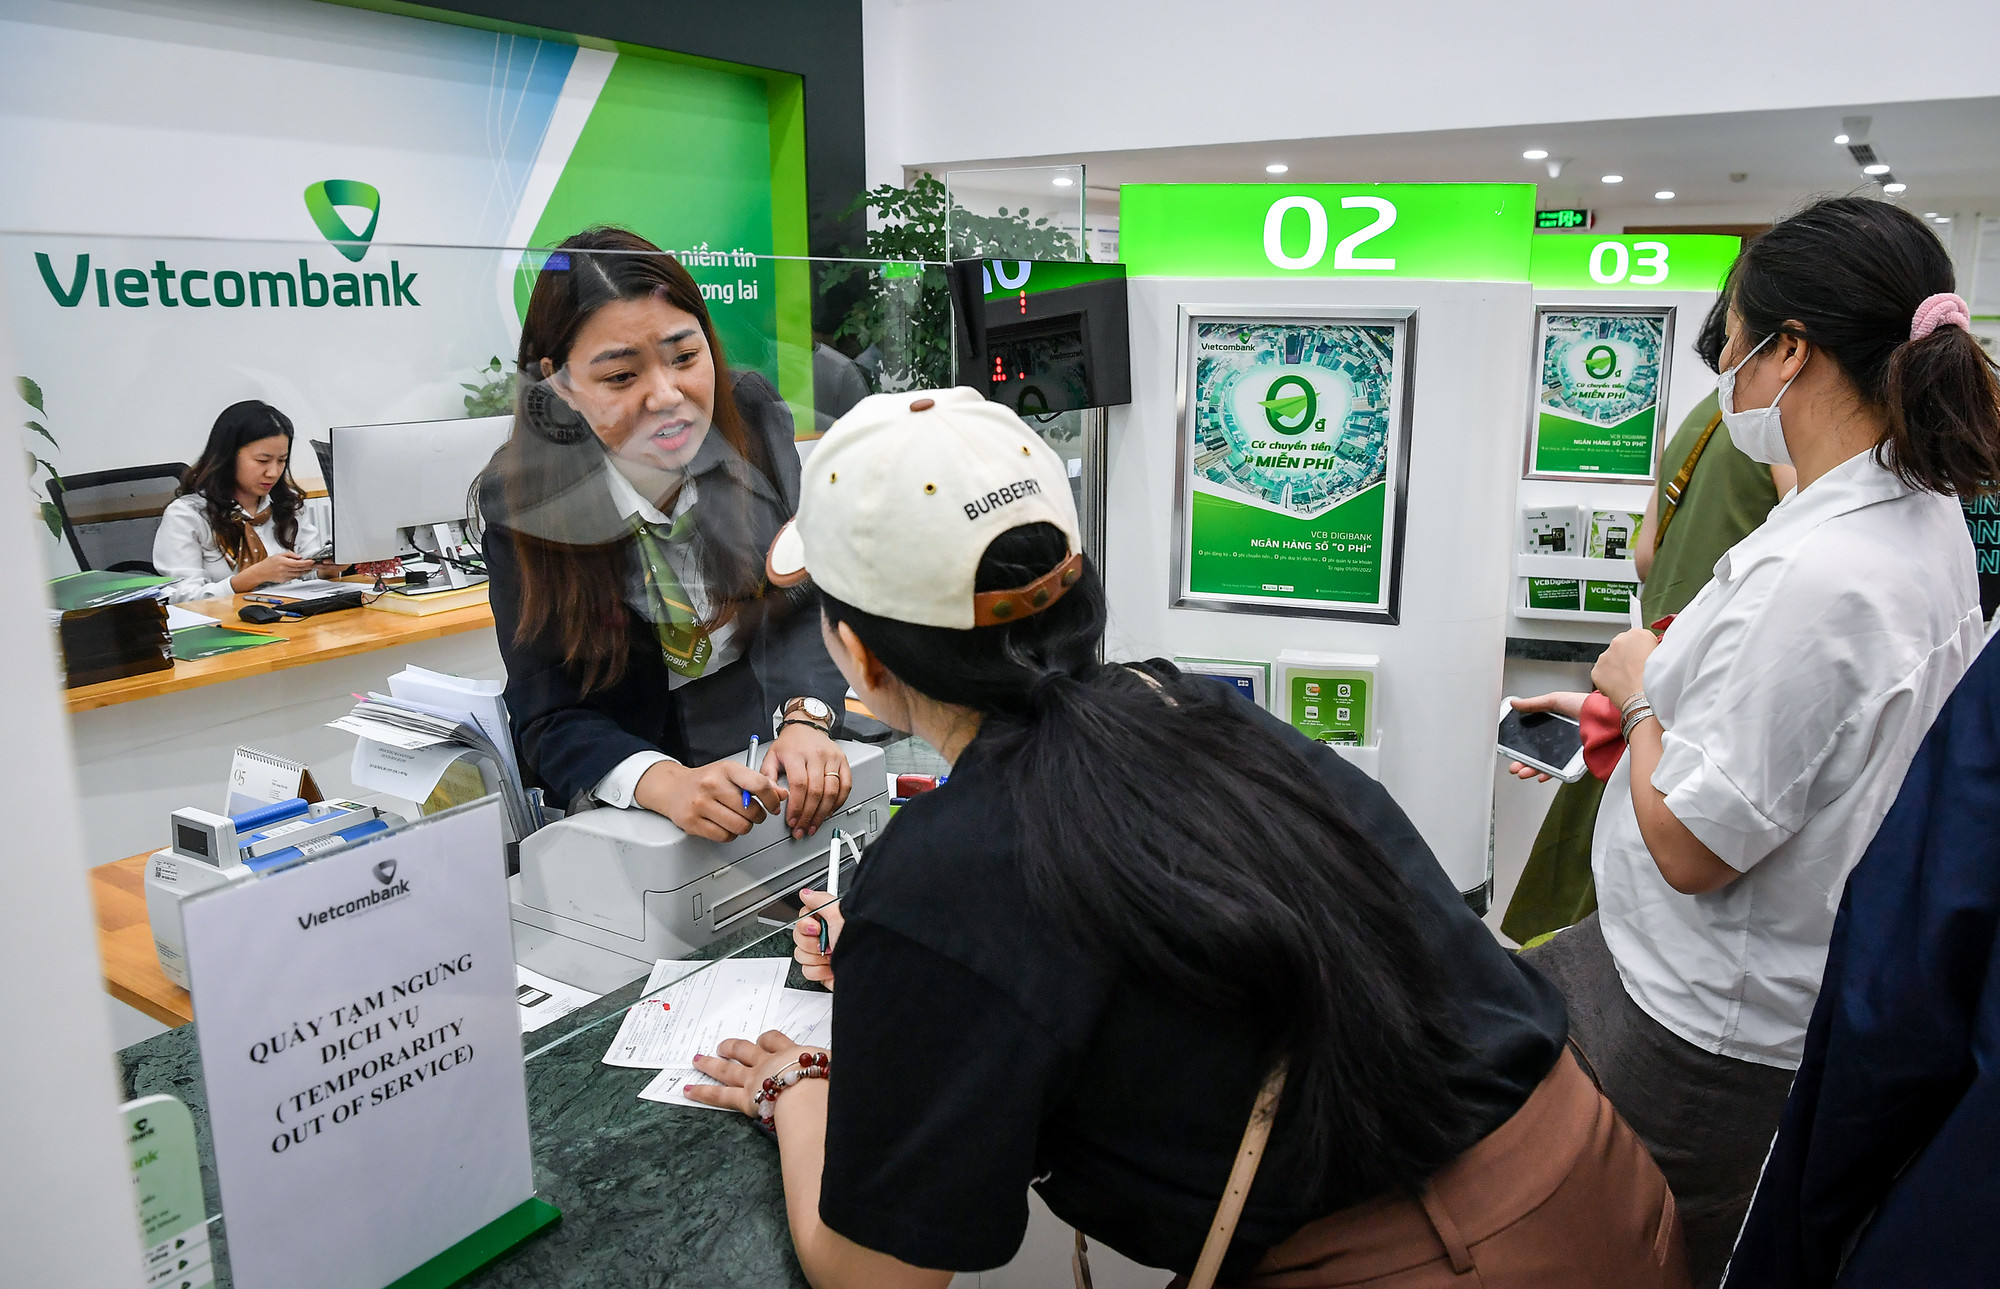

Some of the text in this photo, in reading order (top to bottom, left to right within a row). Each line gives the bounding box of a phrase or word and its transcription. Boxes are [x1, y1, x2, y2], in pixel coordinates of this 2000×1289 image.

[1263, 195, 1397, 270] 02
[681, 242, 728, 266] niềm
[731, 248, 756, 267] tin
[1589, 241, 1669, 284] 03
[34, 252, 421, 308] Vietcombank
[697, 279, 758, 304] ơng lai
[1201, 342, 1256, 352] Vietcombank
[1607, 391, 1626, 400] PHÍ
[1251, 440, 1331, 452] Cứ chuyển tiền
[1255, 452, 1299, 469] MIỄN
[1303, 454, 1335, 470] PHÍ
[964, 479, 1042, 521] BURBERRY
[1250, 538, 1280, 548] NGÂN
[1282, 538, 1312, 550] HÀNG
[1314, 540, 1329, 551] SỐ
[1310, 531, 1373, 541] VCB DIGIBANK
[234, 769, 246, 787] 05
[298, 879, 410, 930] Vietcombank
[330, 991, 385, 1025] TẠM
[392, 953, 473, 1003] NGƯNG
[320, 1005, 420, 1064] DỊCH VỤ
[290, 1017, 464, 1113] TEMPORARITY
[271, 1044, 474, 1154] OUT OF SERVICE)
